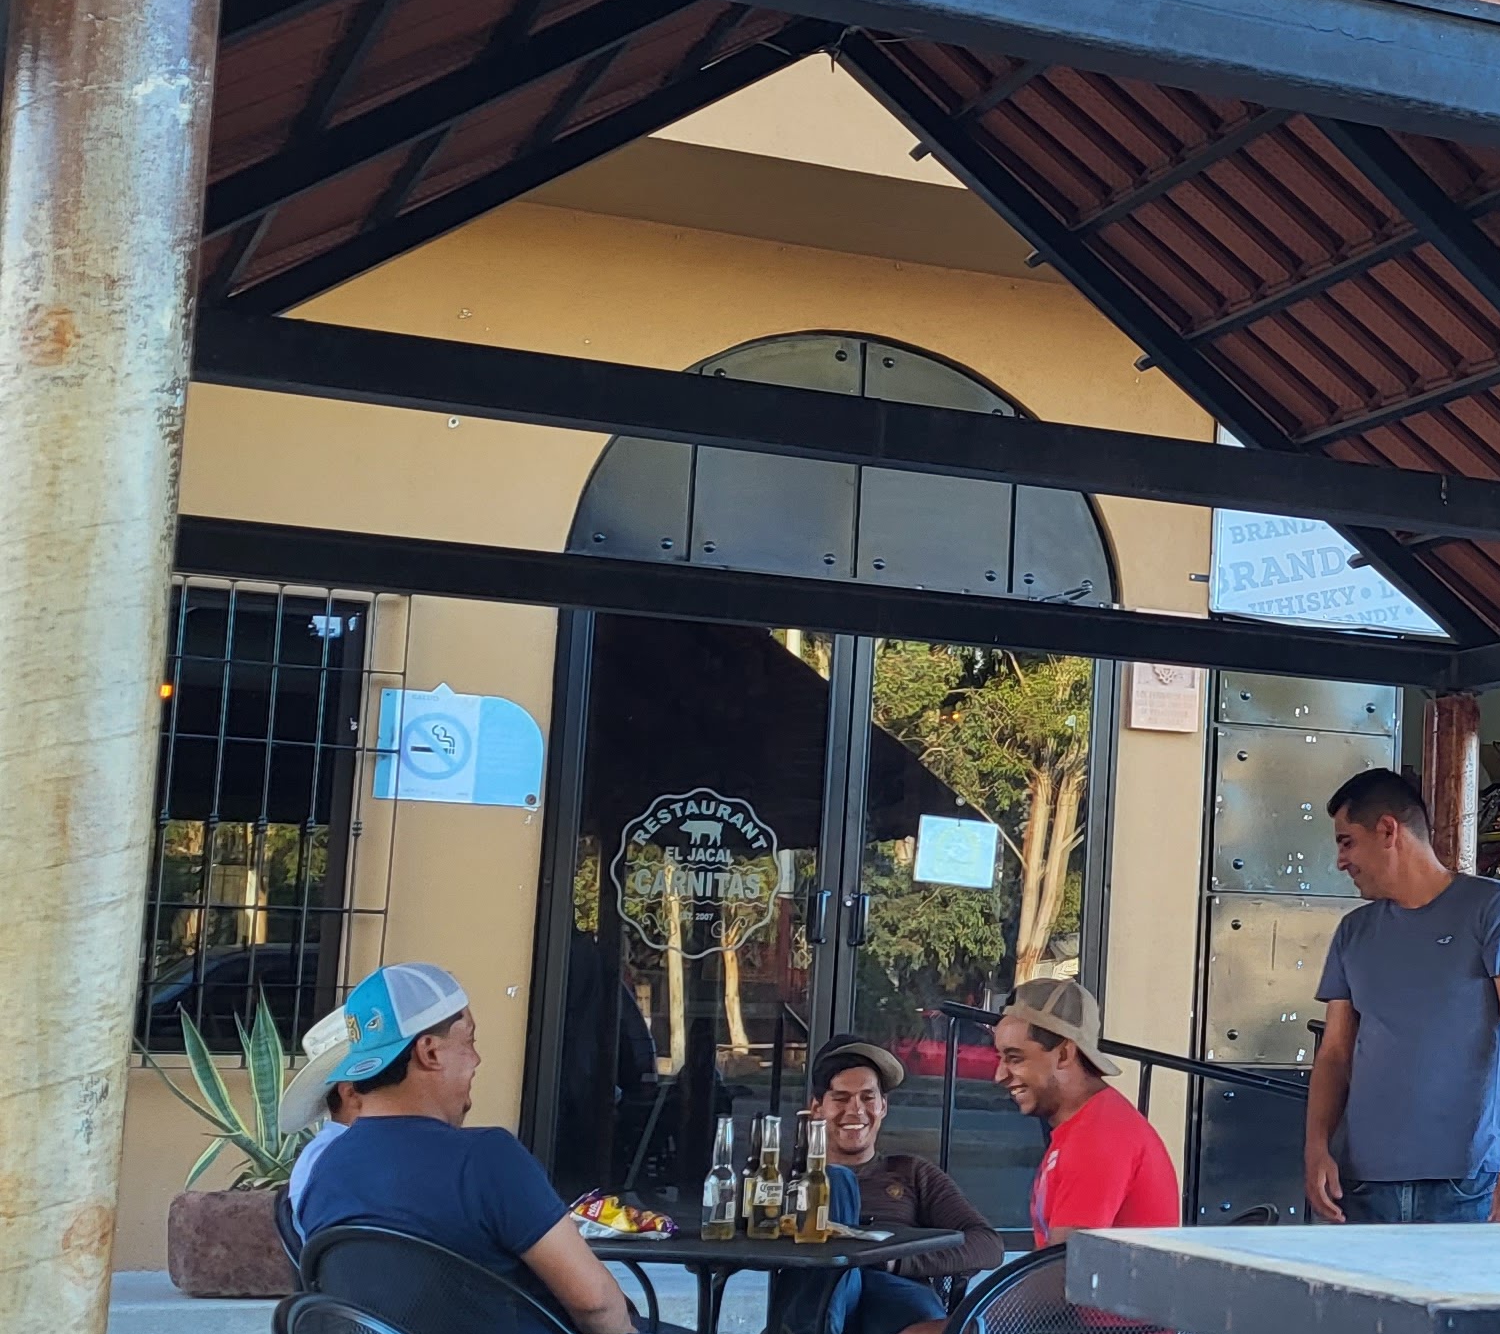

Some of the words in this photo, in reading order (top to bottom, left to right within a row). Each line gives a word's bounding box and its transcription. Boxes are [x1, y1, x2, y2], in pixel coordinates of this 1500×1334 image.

[1229, 519, 1328, 544] BRAND
[1219, 545, 1359, 594] BRAND
[632, 800, 768, 850] RESTAURANT
[665, 846, 683, 860] EL
[687, 848, 734, 863] JACAL
[634, 868, 760, 899] CARNITAS
